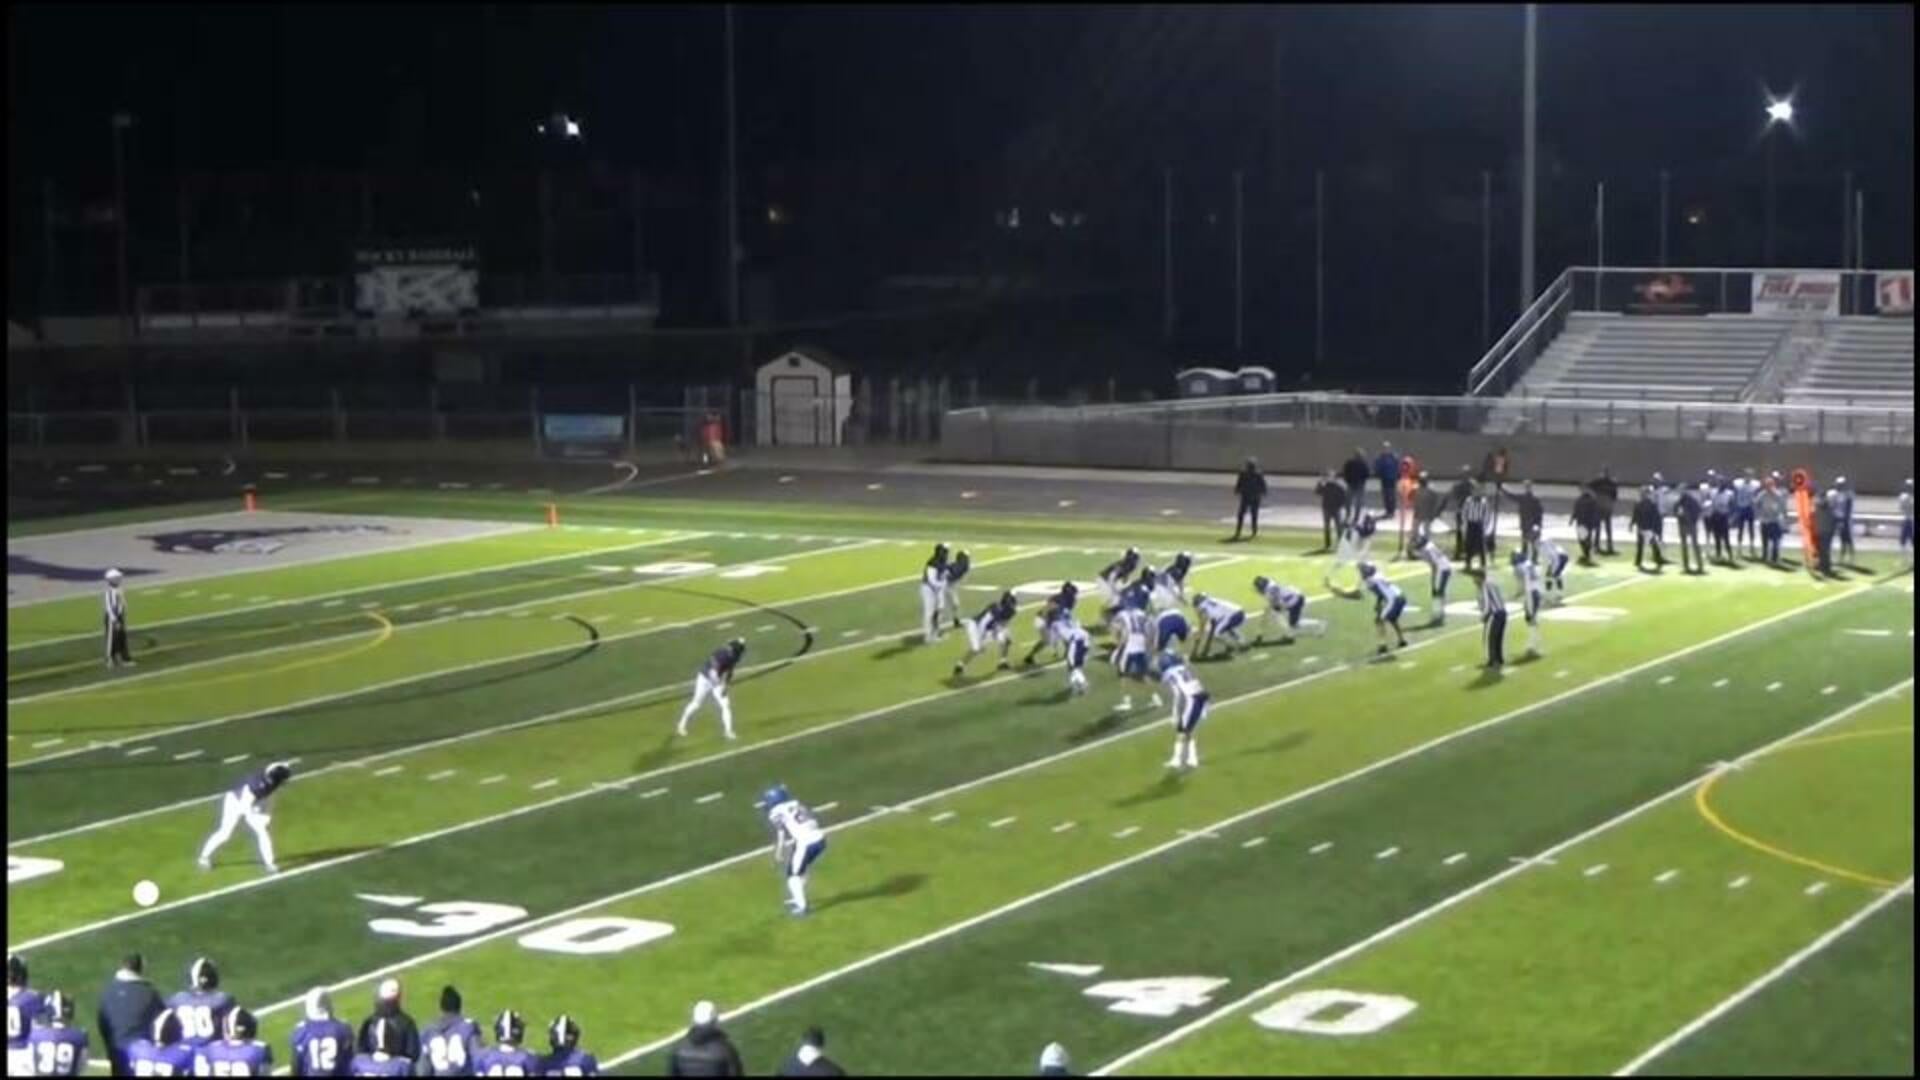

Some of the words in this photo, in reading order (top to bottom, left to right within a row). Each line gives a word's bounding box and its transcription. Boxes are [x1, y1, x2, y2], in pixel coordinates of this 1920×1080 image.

[368, 902, 674, 953] 30
[1082, 976, 1418, 1034] 40
[309, 1037, 337, 1070] 12
